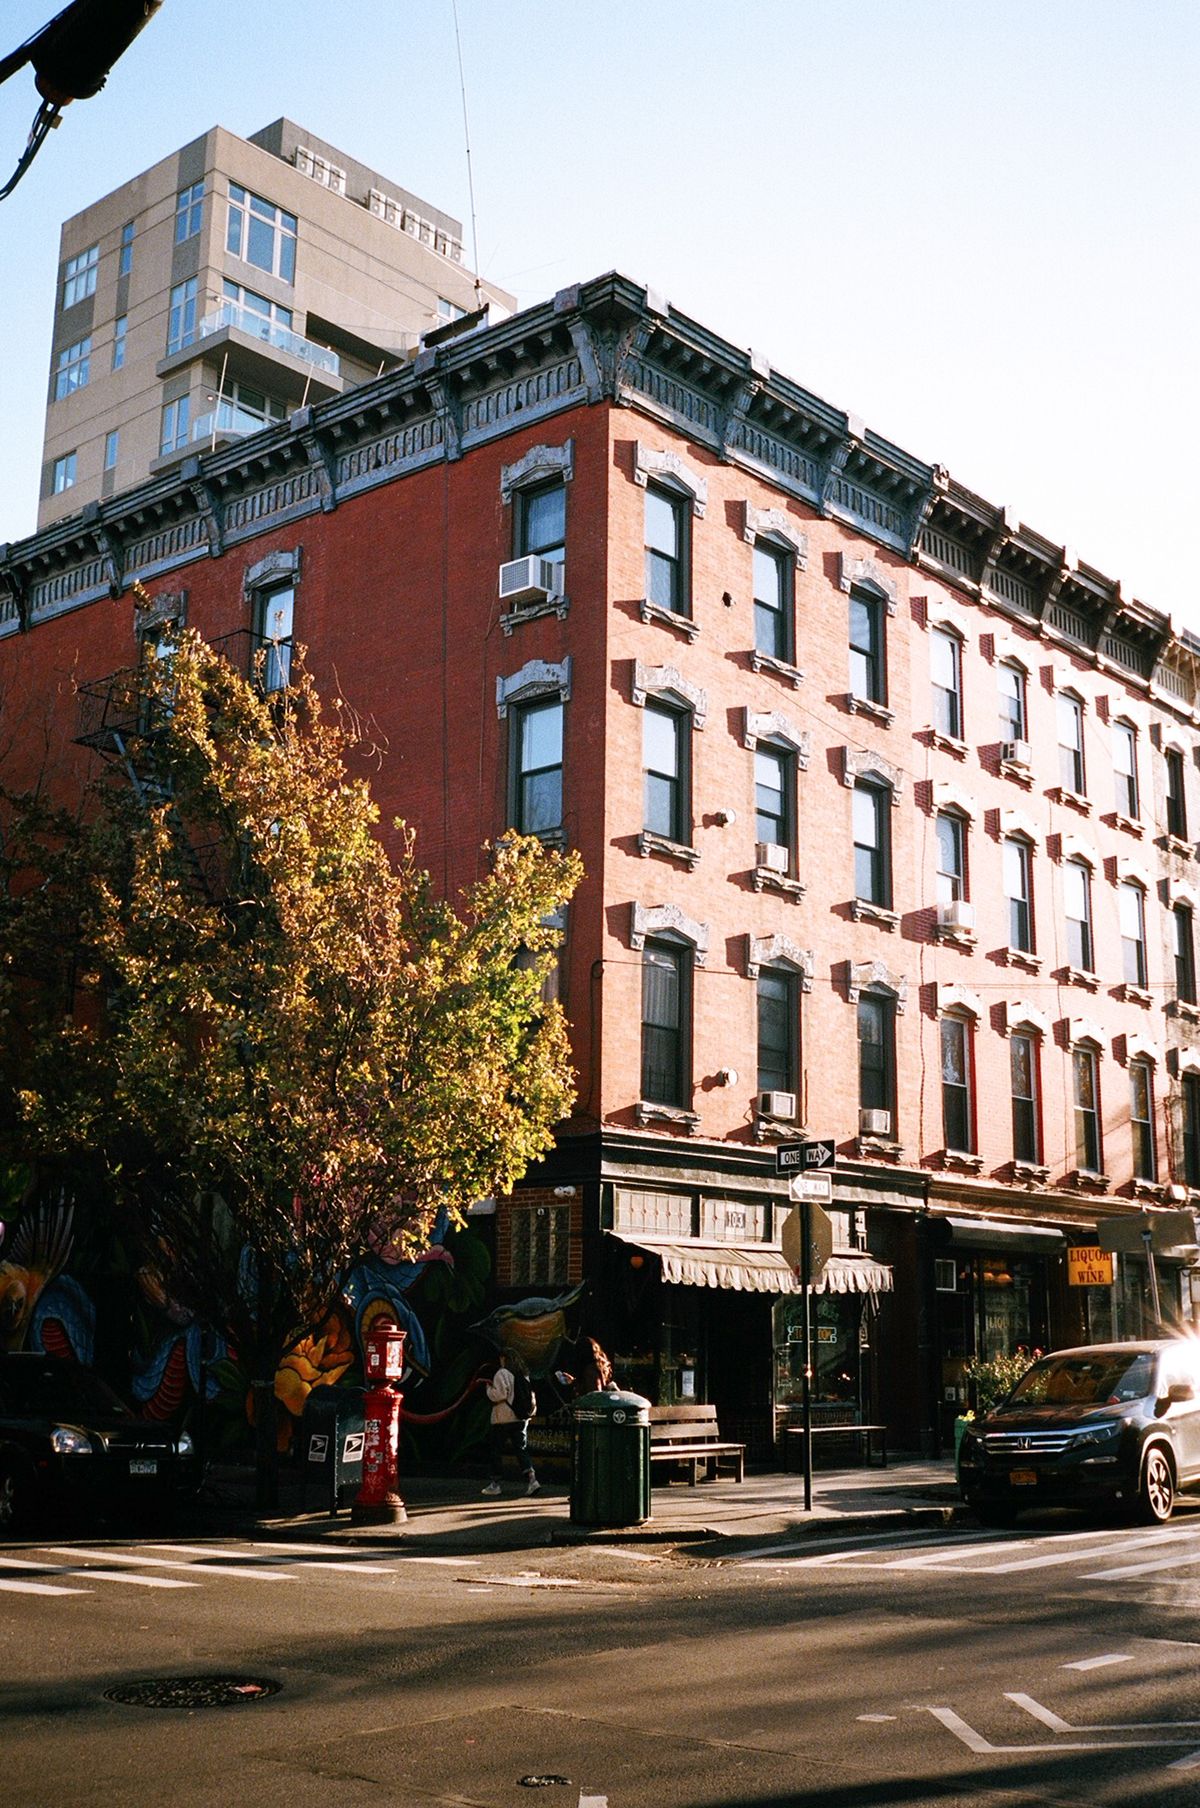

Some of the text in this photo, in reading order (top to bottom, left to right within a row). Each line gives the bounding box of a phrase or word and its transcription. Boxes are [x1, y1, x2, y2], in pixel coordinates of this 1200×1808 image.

[784, 1149, 827, 1164] ONE WAY
[796, 1181, 827, 1192] ONE WAY
[1070, 1249, 1110, 1264] LIQUOR
[1077, 1270, 1105, 1283] WINE
